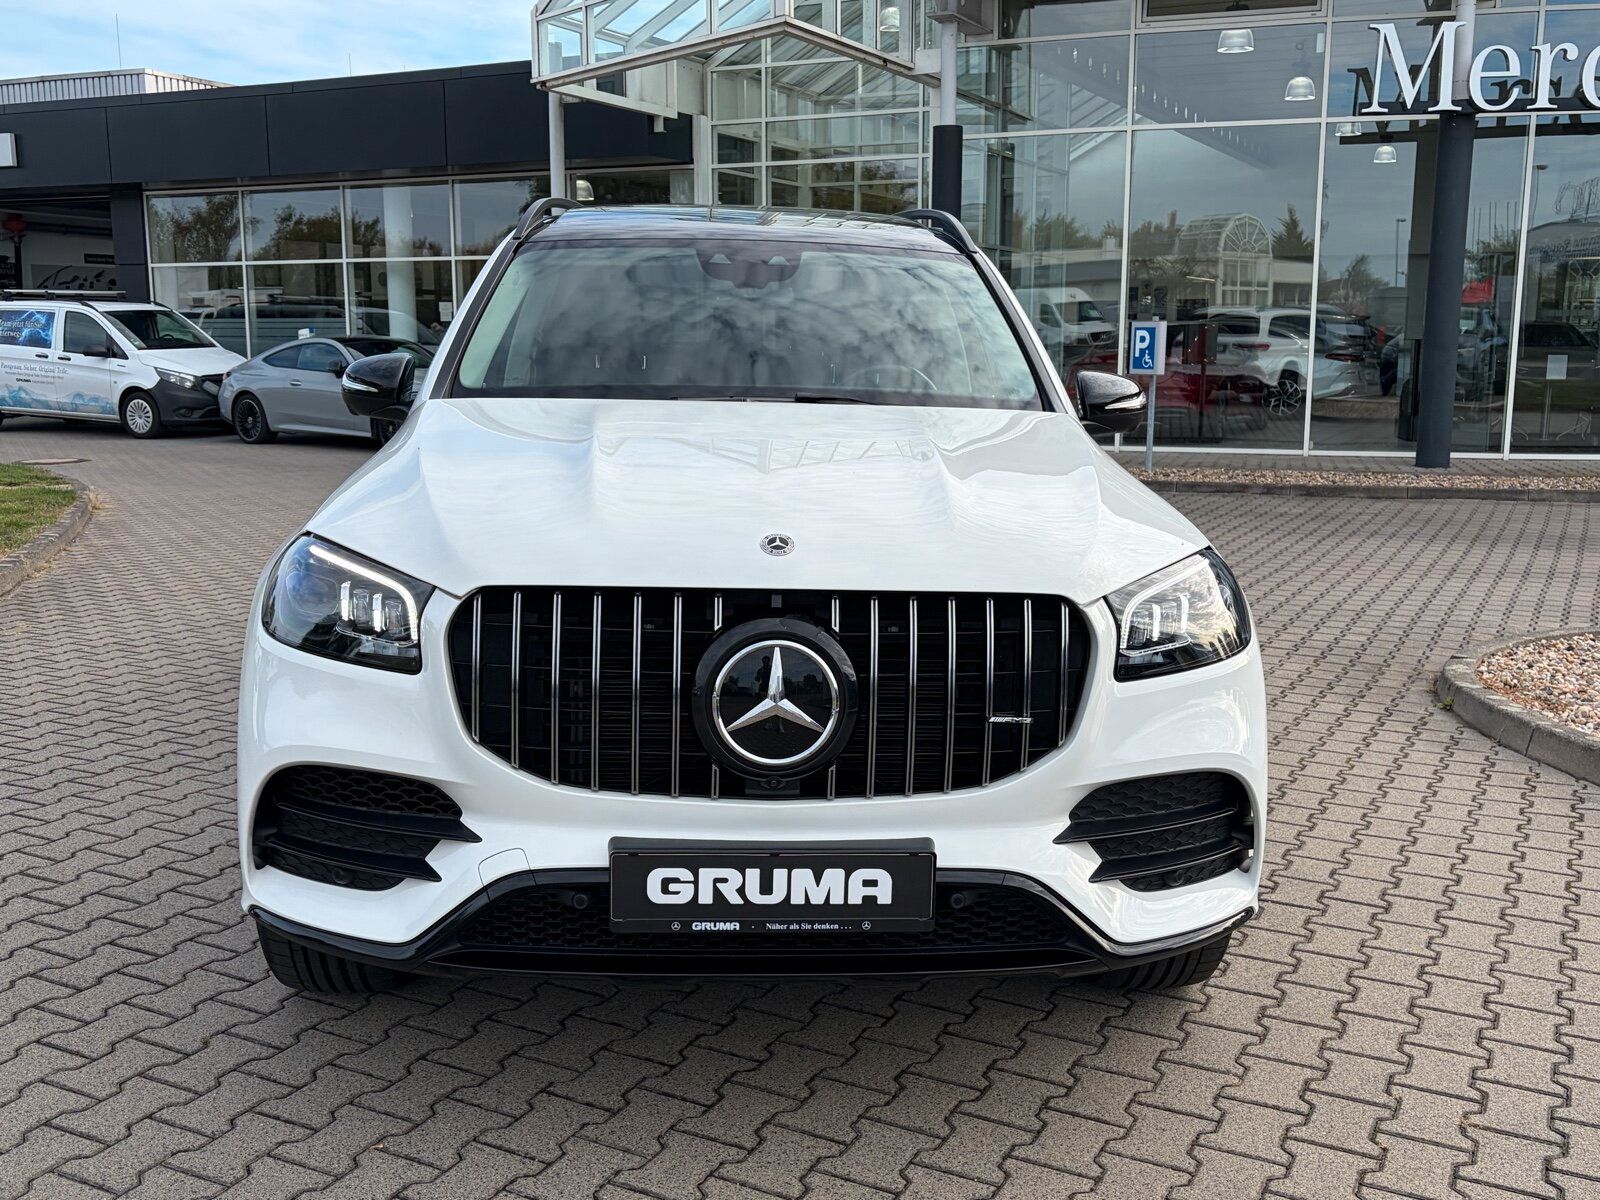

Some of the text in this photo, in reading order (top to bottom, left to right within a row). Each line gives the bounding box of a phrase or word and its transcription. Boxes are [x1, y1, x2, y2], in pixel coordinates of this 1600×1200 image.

[1135, 329, 1150, 357] P
[646, 867, 893, 905] GRUMA
[692, 922, 740, 930] GRUMA
[766, 922, 788, 930] Näher
[789, 922, 800, 930] als
[800, 922, 813, 930] Sie
